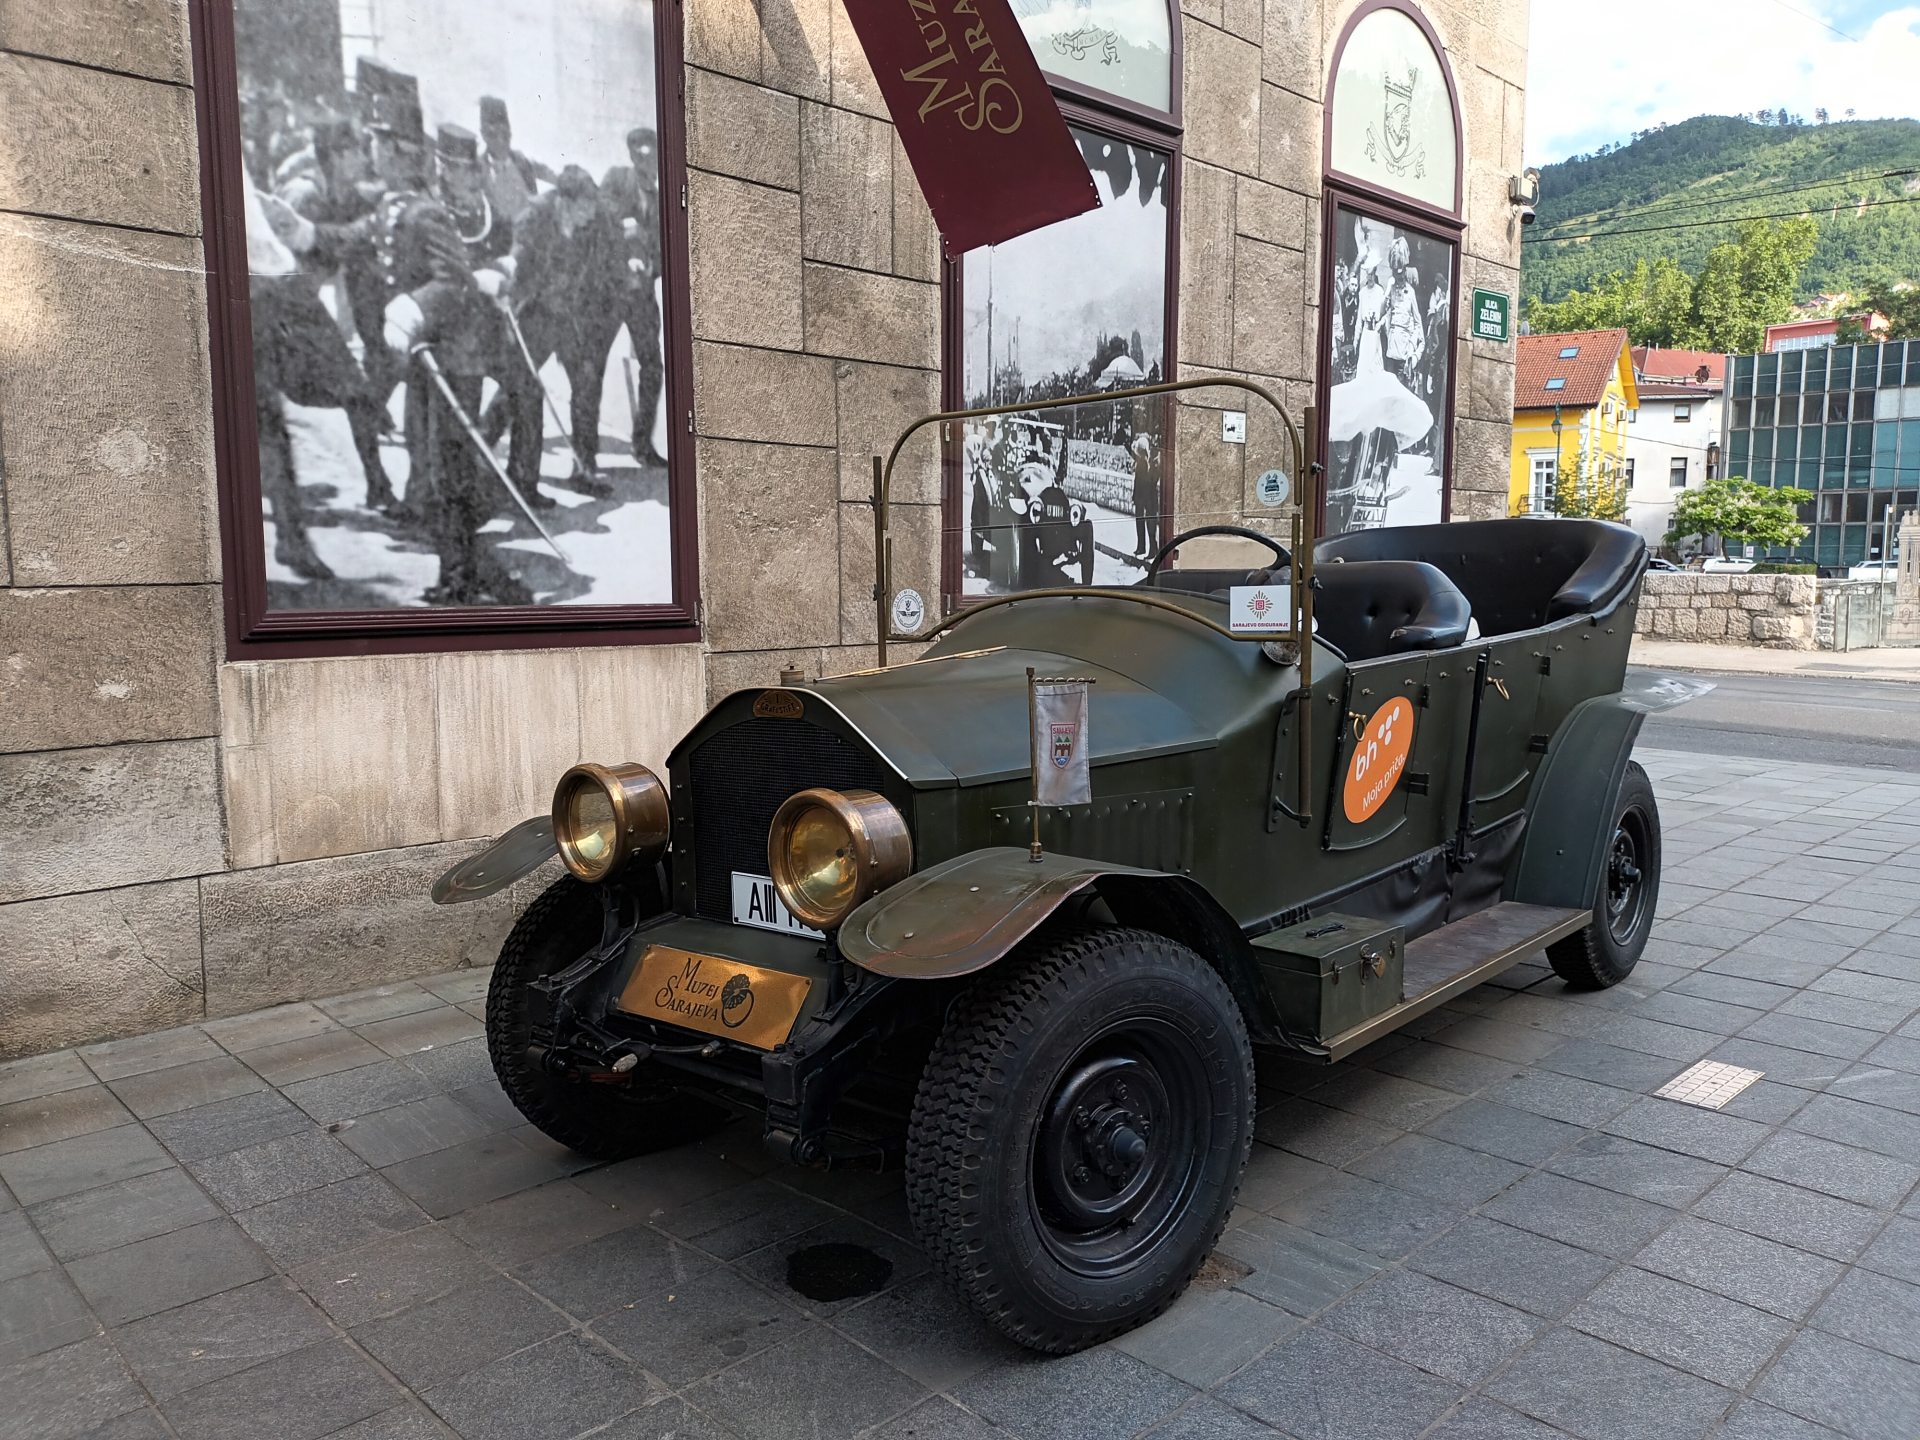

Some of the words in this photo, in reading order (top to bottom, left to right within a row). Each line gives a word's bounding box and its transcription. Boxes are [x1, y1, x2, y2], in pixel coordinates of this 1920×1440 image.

[1363, 782, 1383, 811] Moja
[655, 975, 719, 1022] SARAJEVA
[676, 957, 721, 1001] MUZEJ
